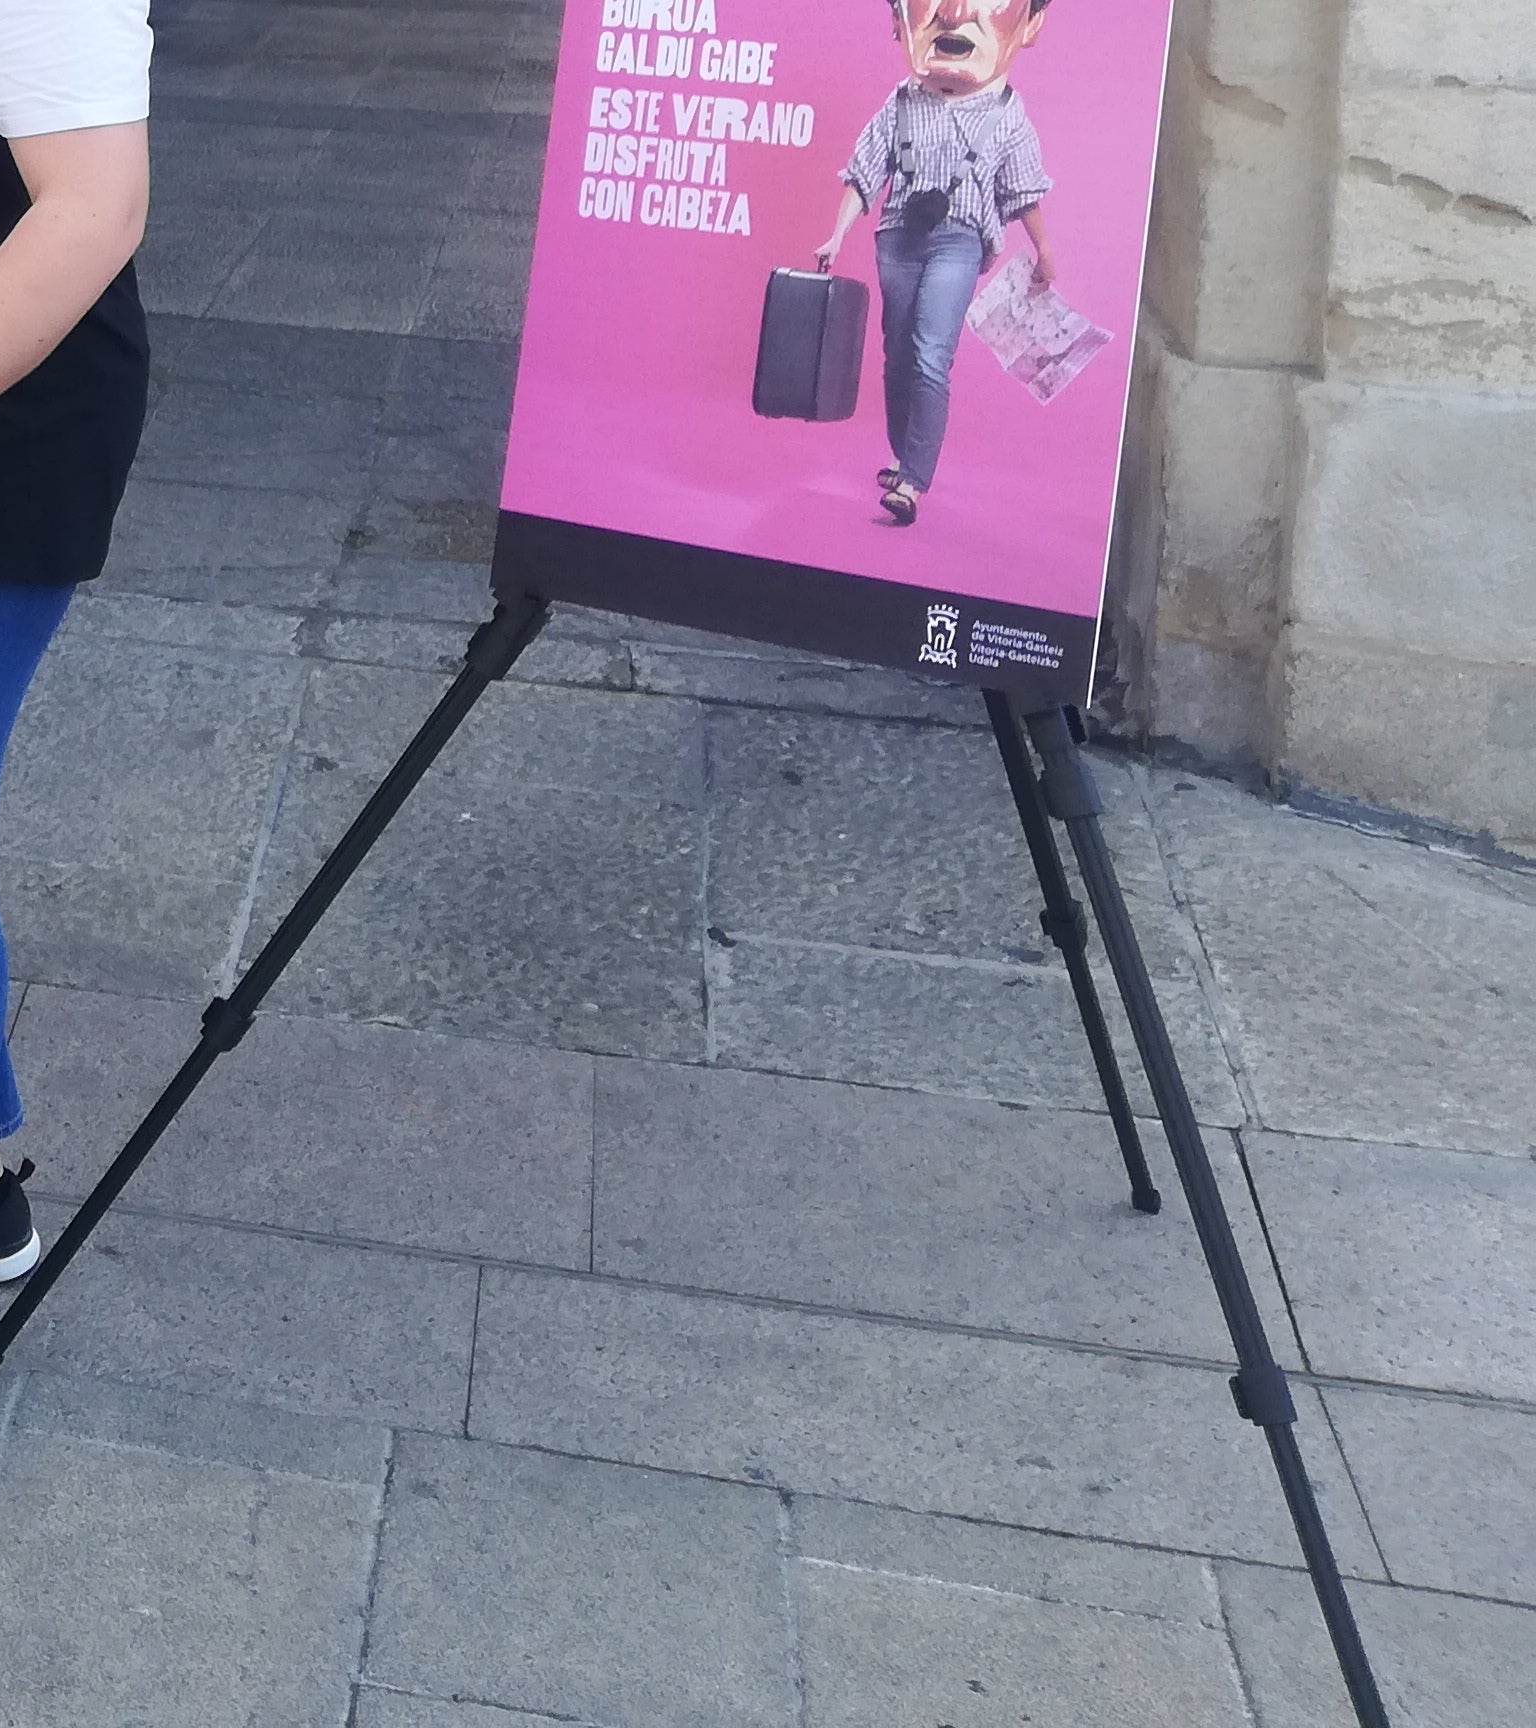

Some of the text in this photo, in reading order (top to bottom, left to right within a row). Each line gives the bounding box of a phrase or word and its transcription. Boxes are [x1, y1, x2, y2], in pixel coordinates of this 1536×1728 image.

[596, 31, 778, 86] GALDU GABE
[589, 86, 815, 148] ESTE VERANO
[583, 131, 727, 186] DISFRUTA
[578, 176, 751, 236] CON CABEZA
[973, 620, 1047, 643] Ayuntamiento
[968, 653, 999, 668] Udala
